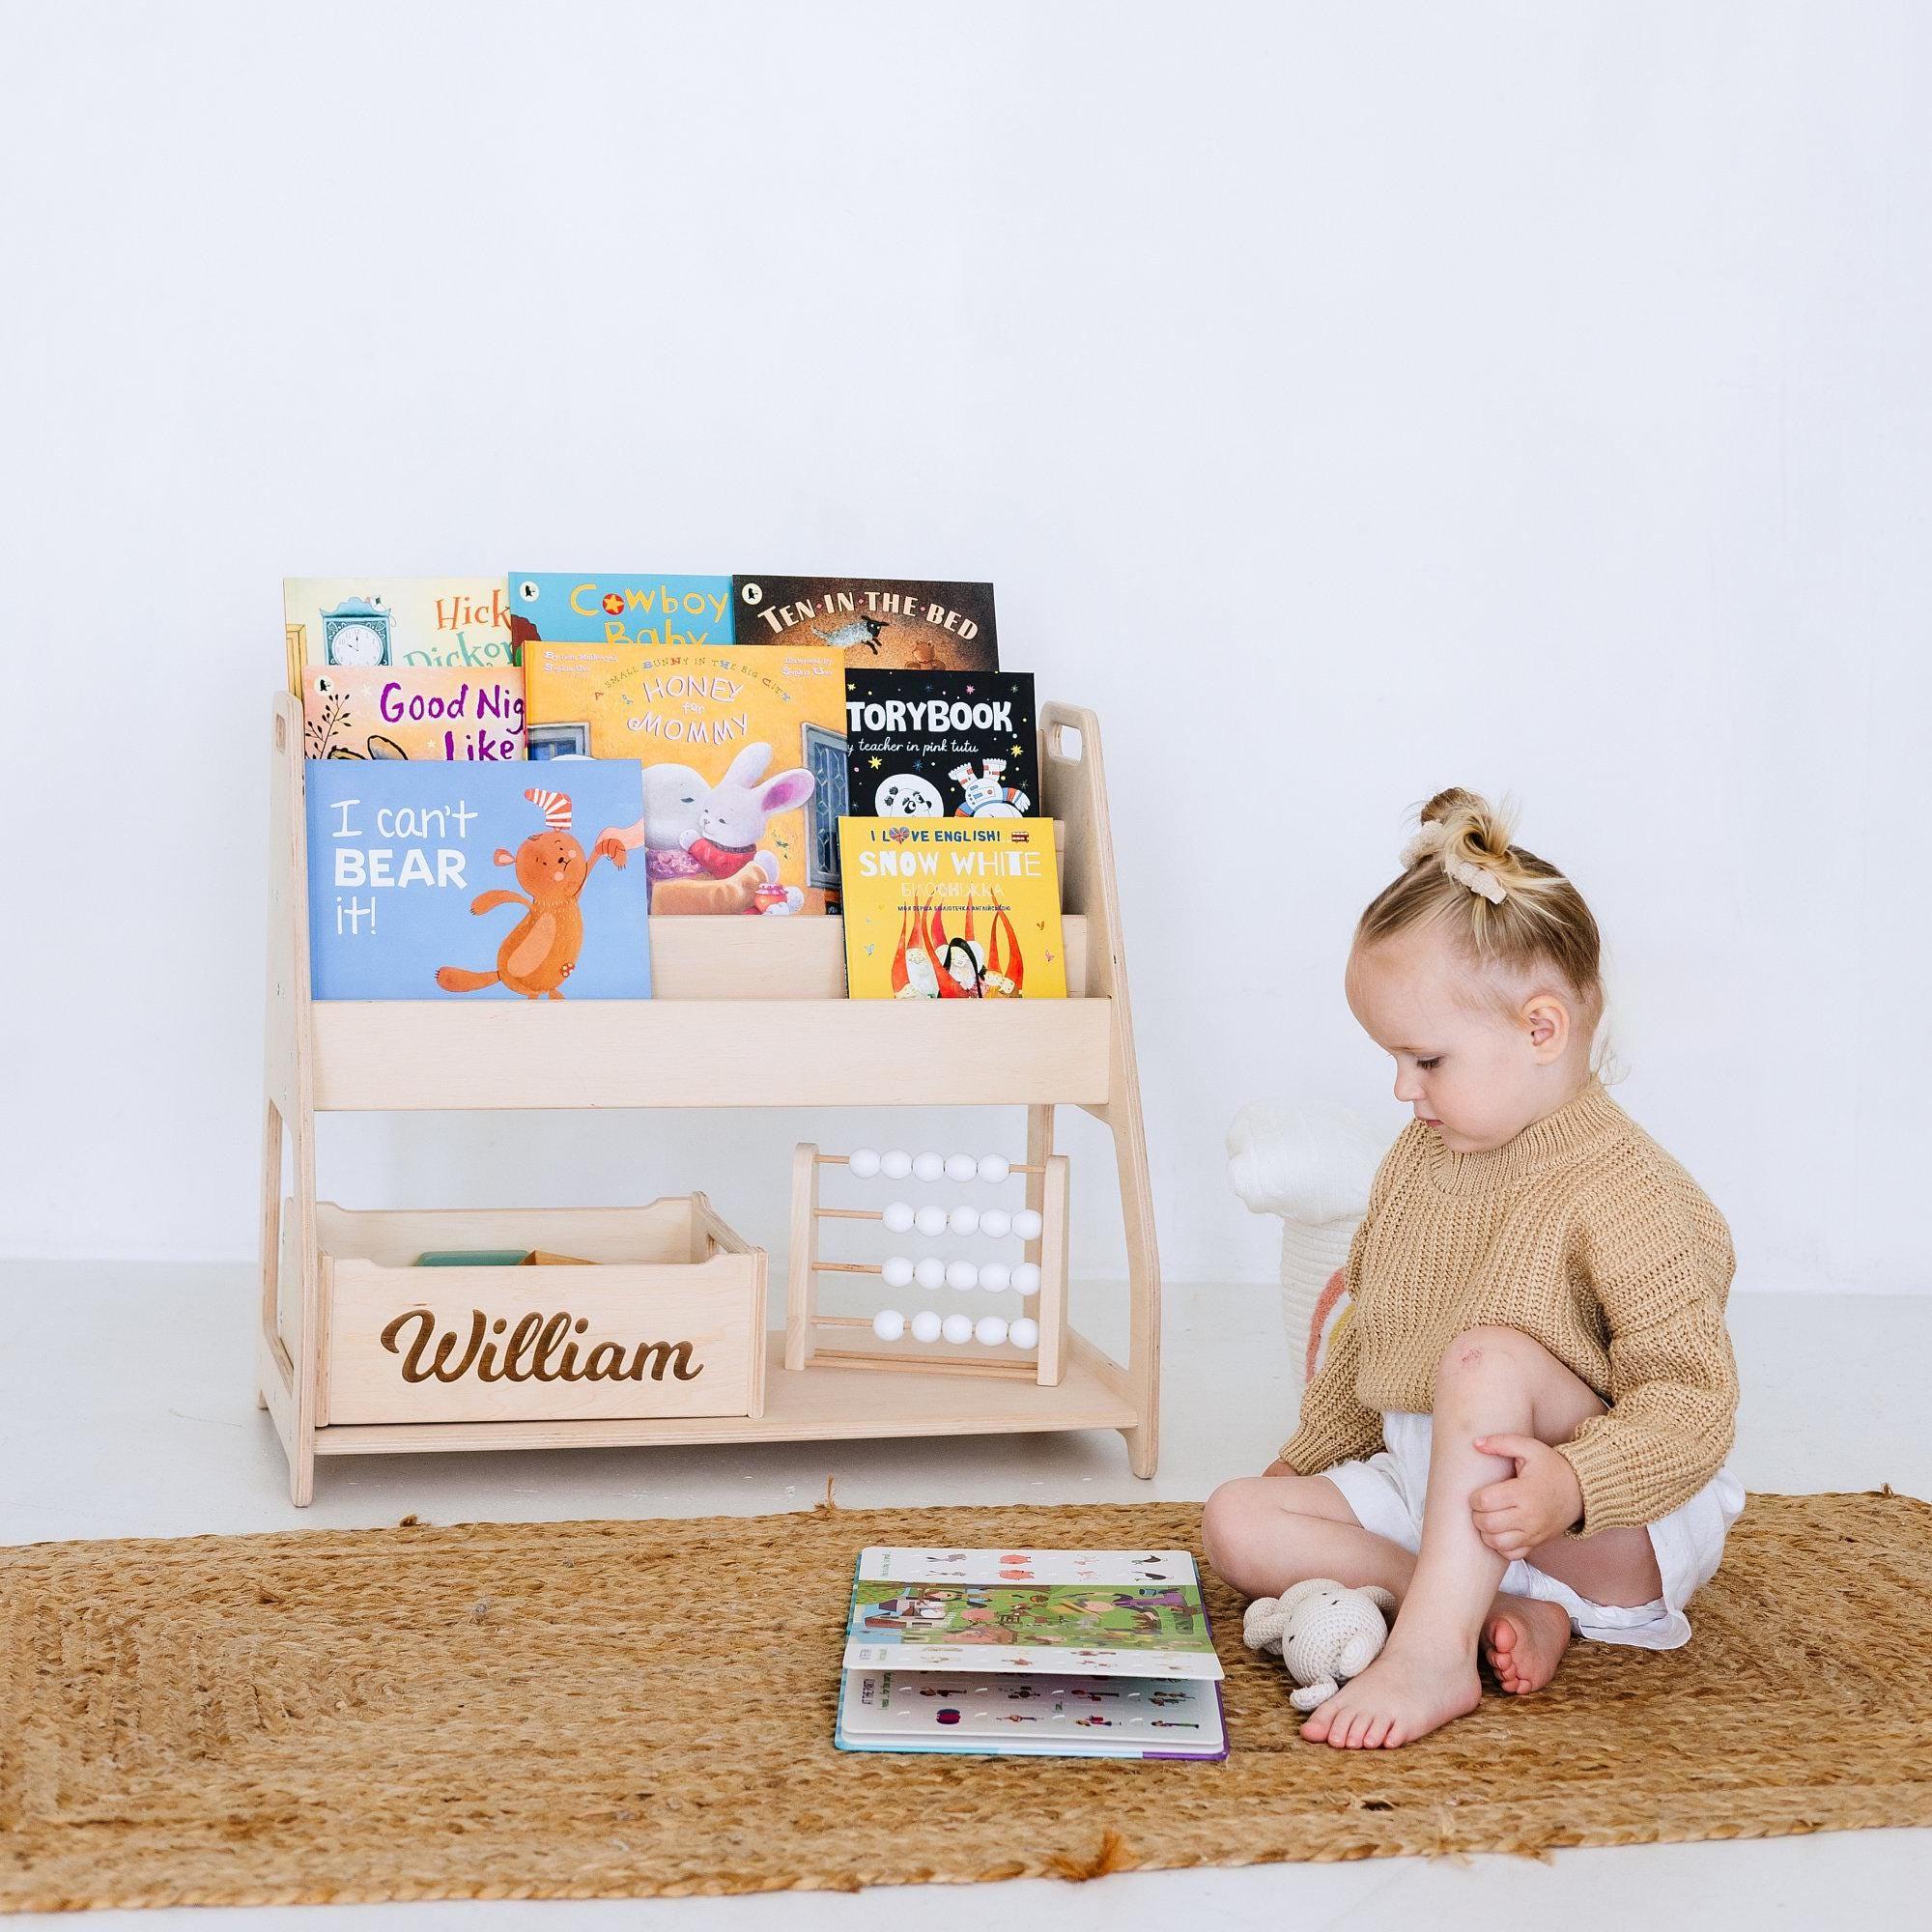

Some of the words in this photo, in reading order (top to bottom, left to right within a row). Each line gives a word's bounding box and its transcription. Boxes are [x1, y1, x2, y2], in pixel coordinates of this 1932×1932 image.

[435, 588, 512, 631] Hick
[570, 583, 728, 623] Cowboy
[757, 598, 818, 635] TEN
[824, 591, 855, 614] IN
[864, 591, 919, 617] THE
[925, 603, 980, 640] BED
[403, 631, 513, 667] Dickor
[604, 667, 639, 688] SMALL
[643, 657, 689, 668] BUNNY
[695, 657, 706, 666] IN
[711, 659, 737, 671] THE
[740, 666, 759, 679] BIG
[642, 675, 744, 703] HONEY
[381, 682, 469, 723] Good
[476, 684, 525, 734] Nig
[682, 701, 705, 715] for
[846, 699, 1012, 732] TORYBOOK
[627, 711, 749, 746] MOMMY
[858, 737, 904, 752] teacher
[906, 741, 920, 752] in
[923, 738, 949, 756] pink
[951, 740, 979, 753] tutu
[329, 799, 363, 838] I
[376, 800, 479, 838] can't
[870, 830, 875, 841] I
[935, 831, 1001, 842] ENGLISH!
[334, 847, 469, 890] BEAR
[859, 850, 940, 877] SNOW
[951, 850, 1042, 877] WHITE
[335, 895, 378, 935] it!
[381, 1308, 704, 1383] William
